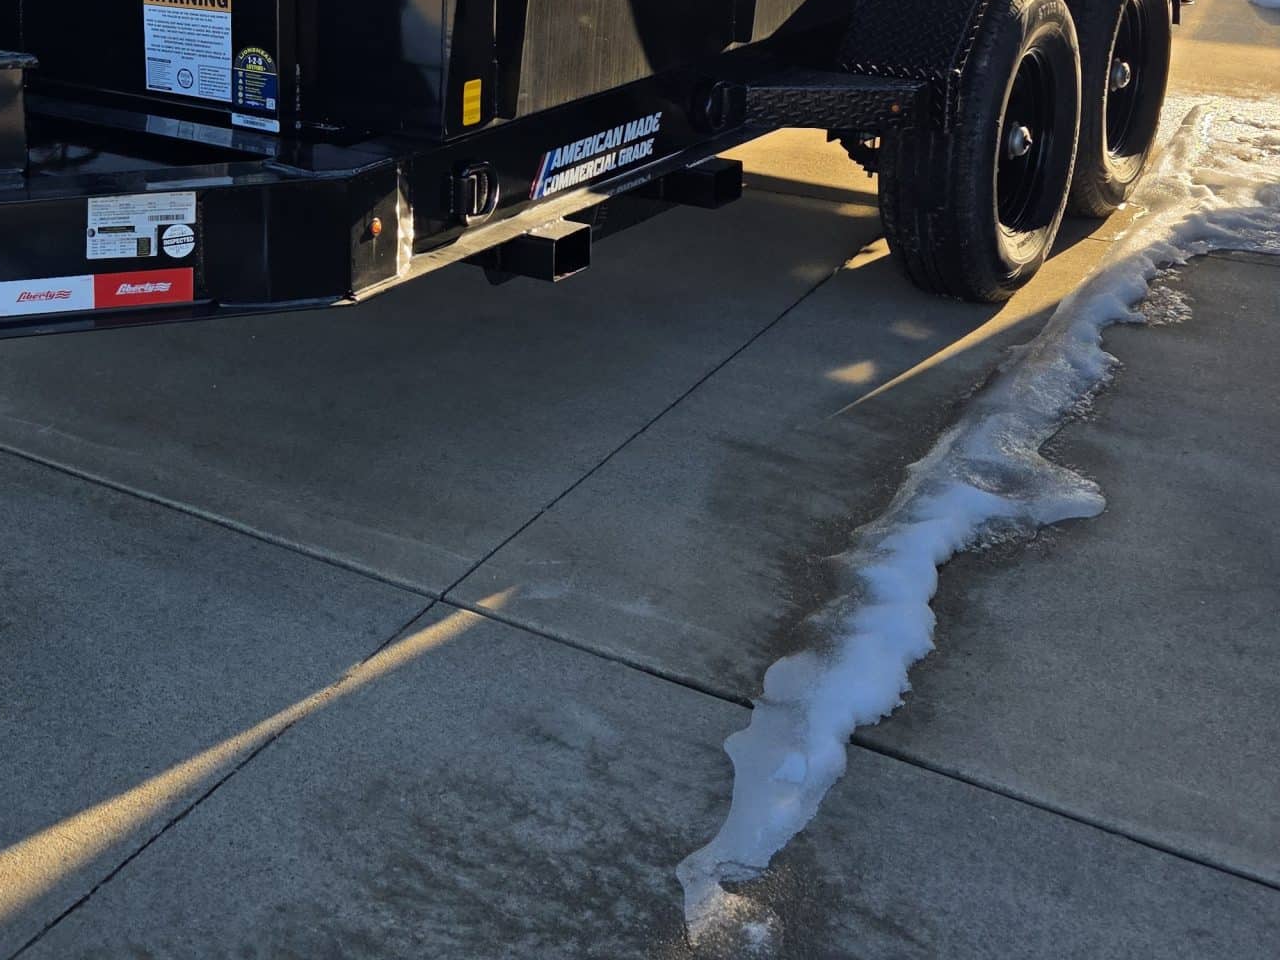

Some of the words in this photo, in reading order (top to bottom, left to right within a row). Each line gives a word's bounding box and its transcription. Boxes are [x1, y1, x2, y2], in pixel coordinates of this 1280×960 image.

[543, 152, 617, 197] COMMERCIAL
[618, 138, 655, 167] GRADE
[551, 125, 624, 170] AMERICAN
[624, 112, 663, 143] MADE
[16, 289, 55, 303] Liberty
[115, 282, 154, 295] Liberty
